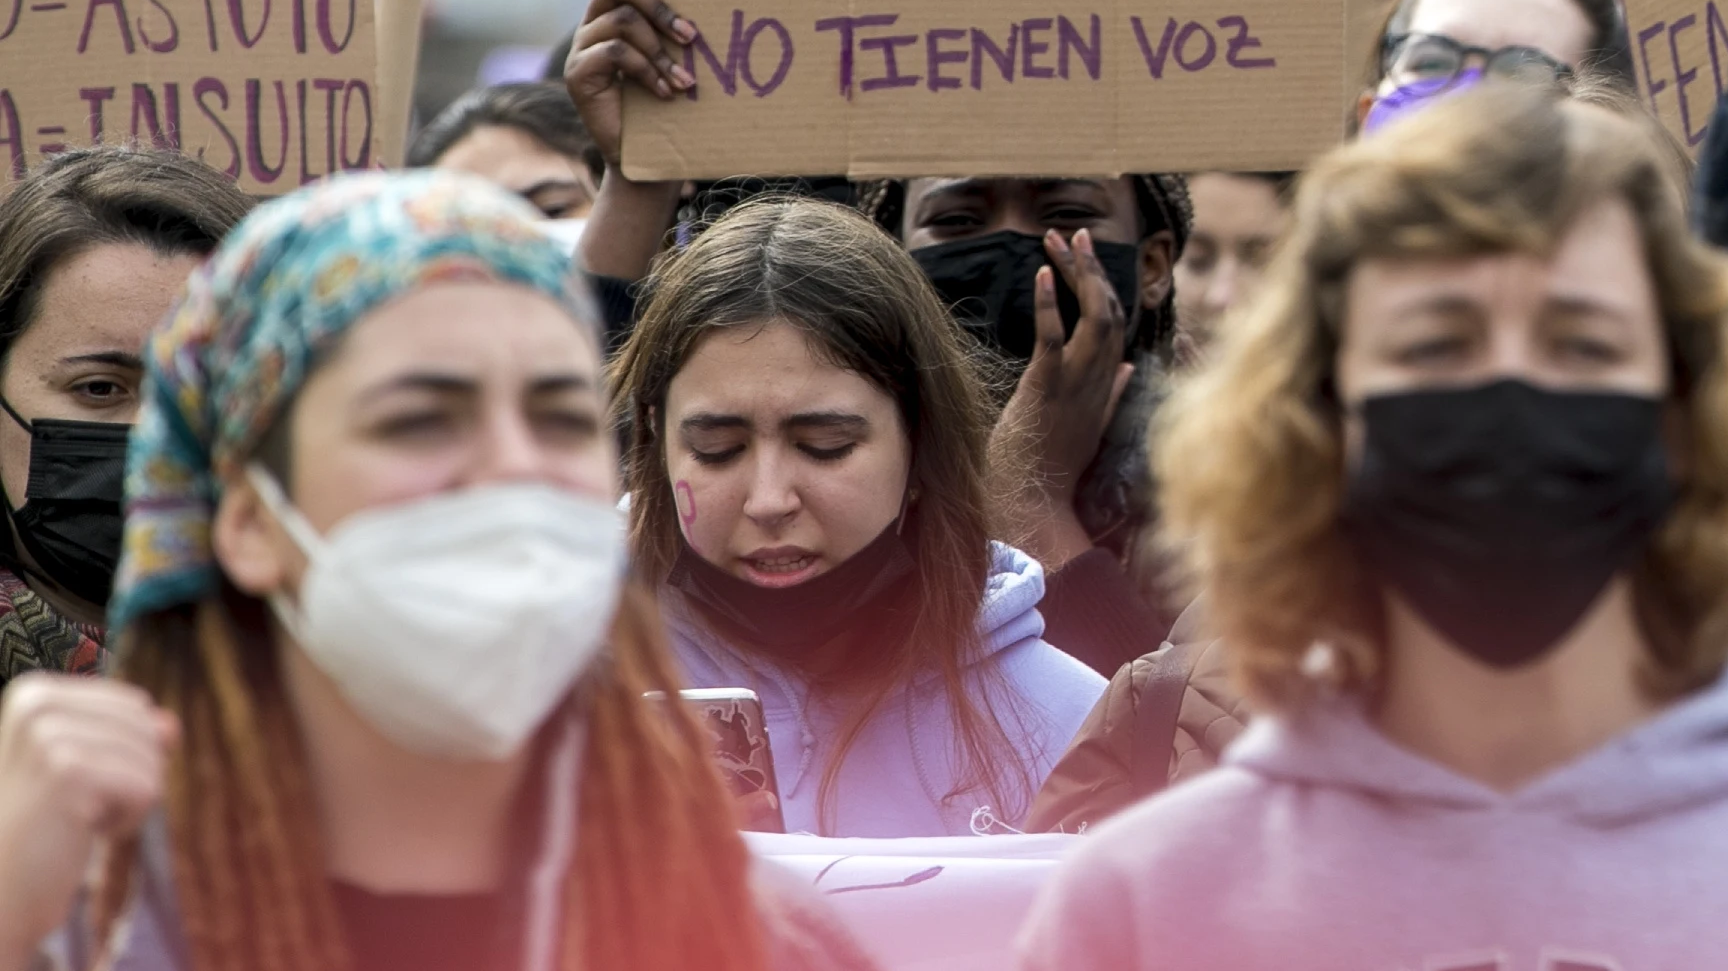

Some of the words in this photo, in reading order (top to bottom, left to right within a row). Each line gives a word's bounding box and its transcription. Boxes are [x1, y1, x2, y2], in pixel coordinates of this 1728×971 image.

[682, 9, 794, 101] NO
[815, 13, 1102, 101] TIENEN
[1130, 14, 1277, 80] VOZ
